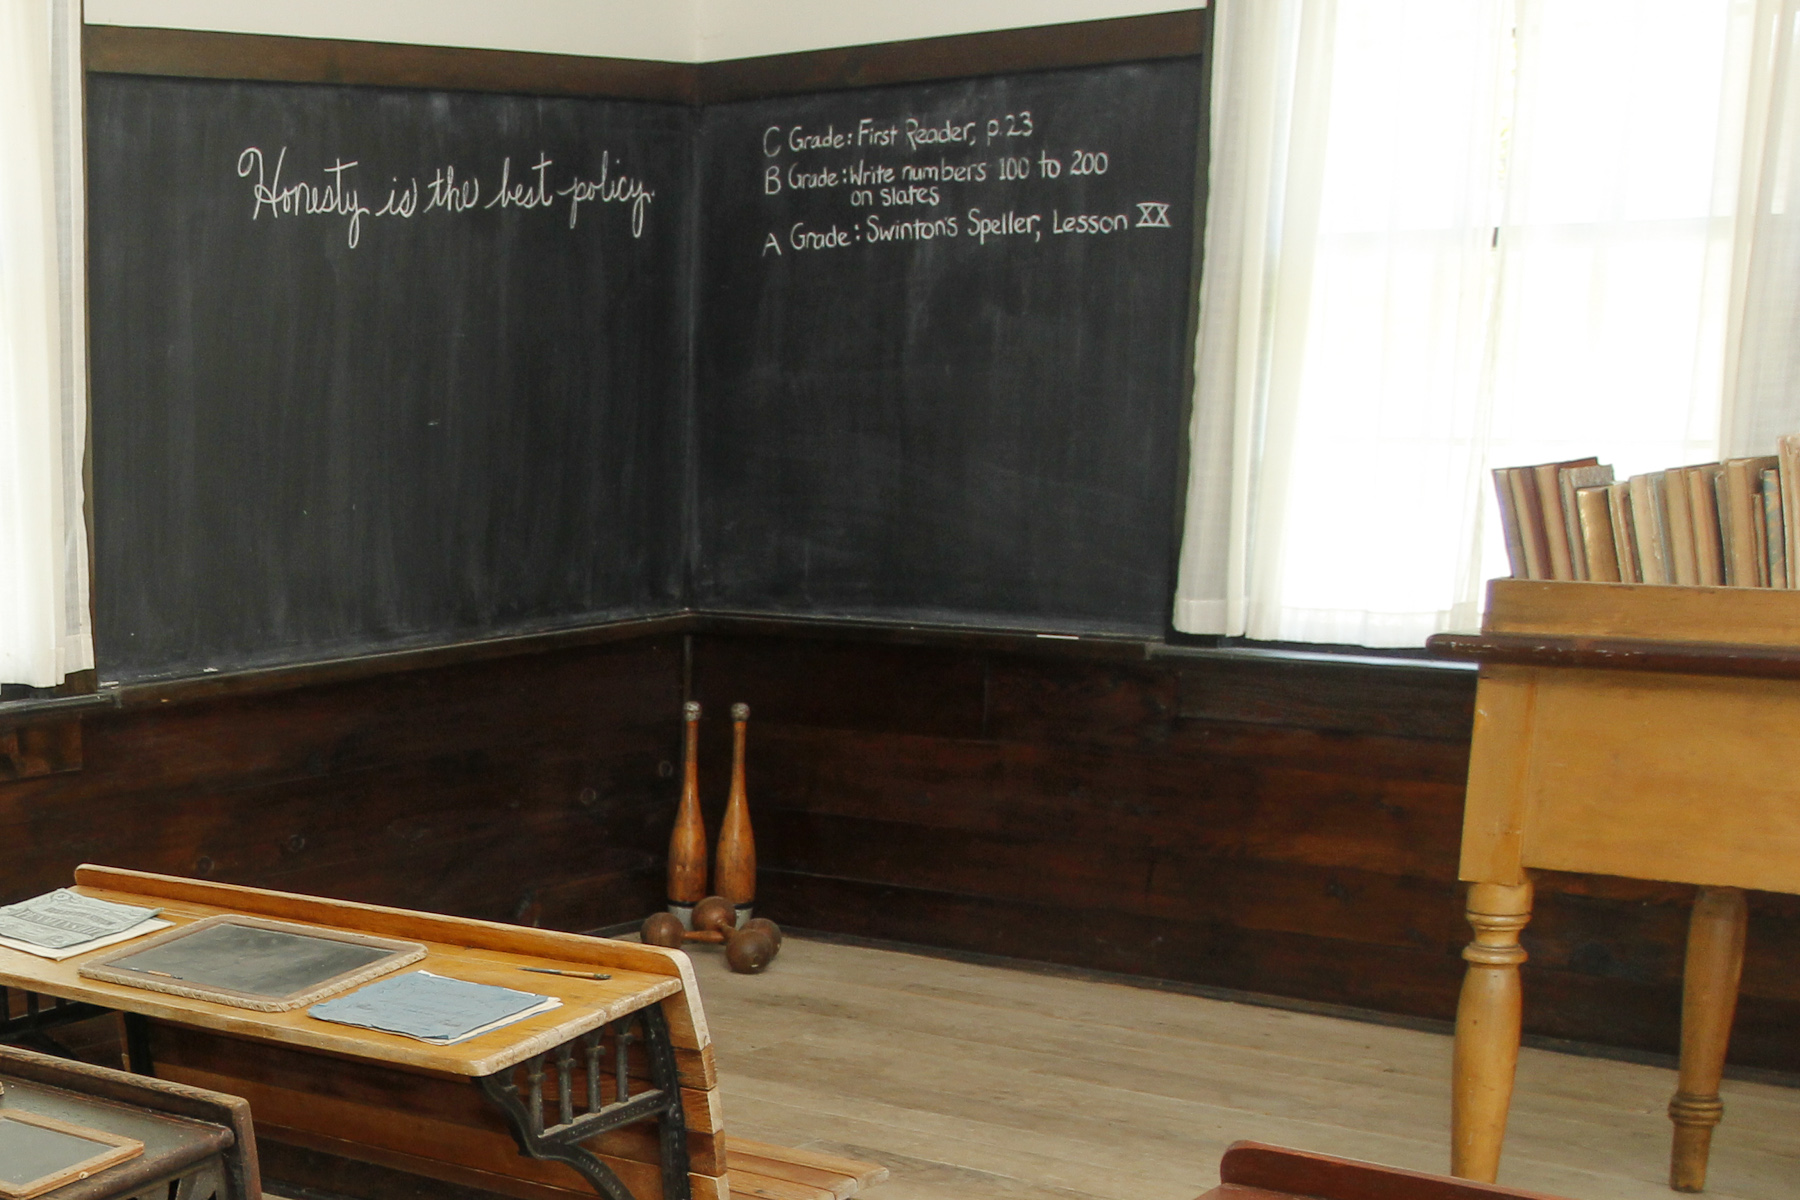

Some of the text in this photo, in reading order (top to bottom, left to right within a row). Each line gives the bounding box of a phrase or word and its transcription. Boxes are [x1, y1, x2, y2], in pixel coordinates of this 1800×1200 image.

[763, 126, 781, 157] C
[788, 125, 852, 151] Grade:
[858, 118, 899, 147] First
[905, 117, 977, 151] Reader,
[764, 150, 1110, 196] B Grade: Write numbers 100 to 200
[237, 146, 656, 249] Honesty is the best policy.
[850, 185, 941, 208] on slates
[761, 201, 1172, 257] A Grade: Swinton's Speller, Lesson XX
